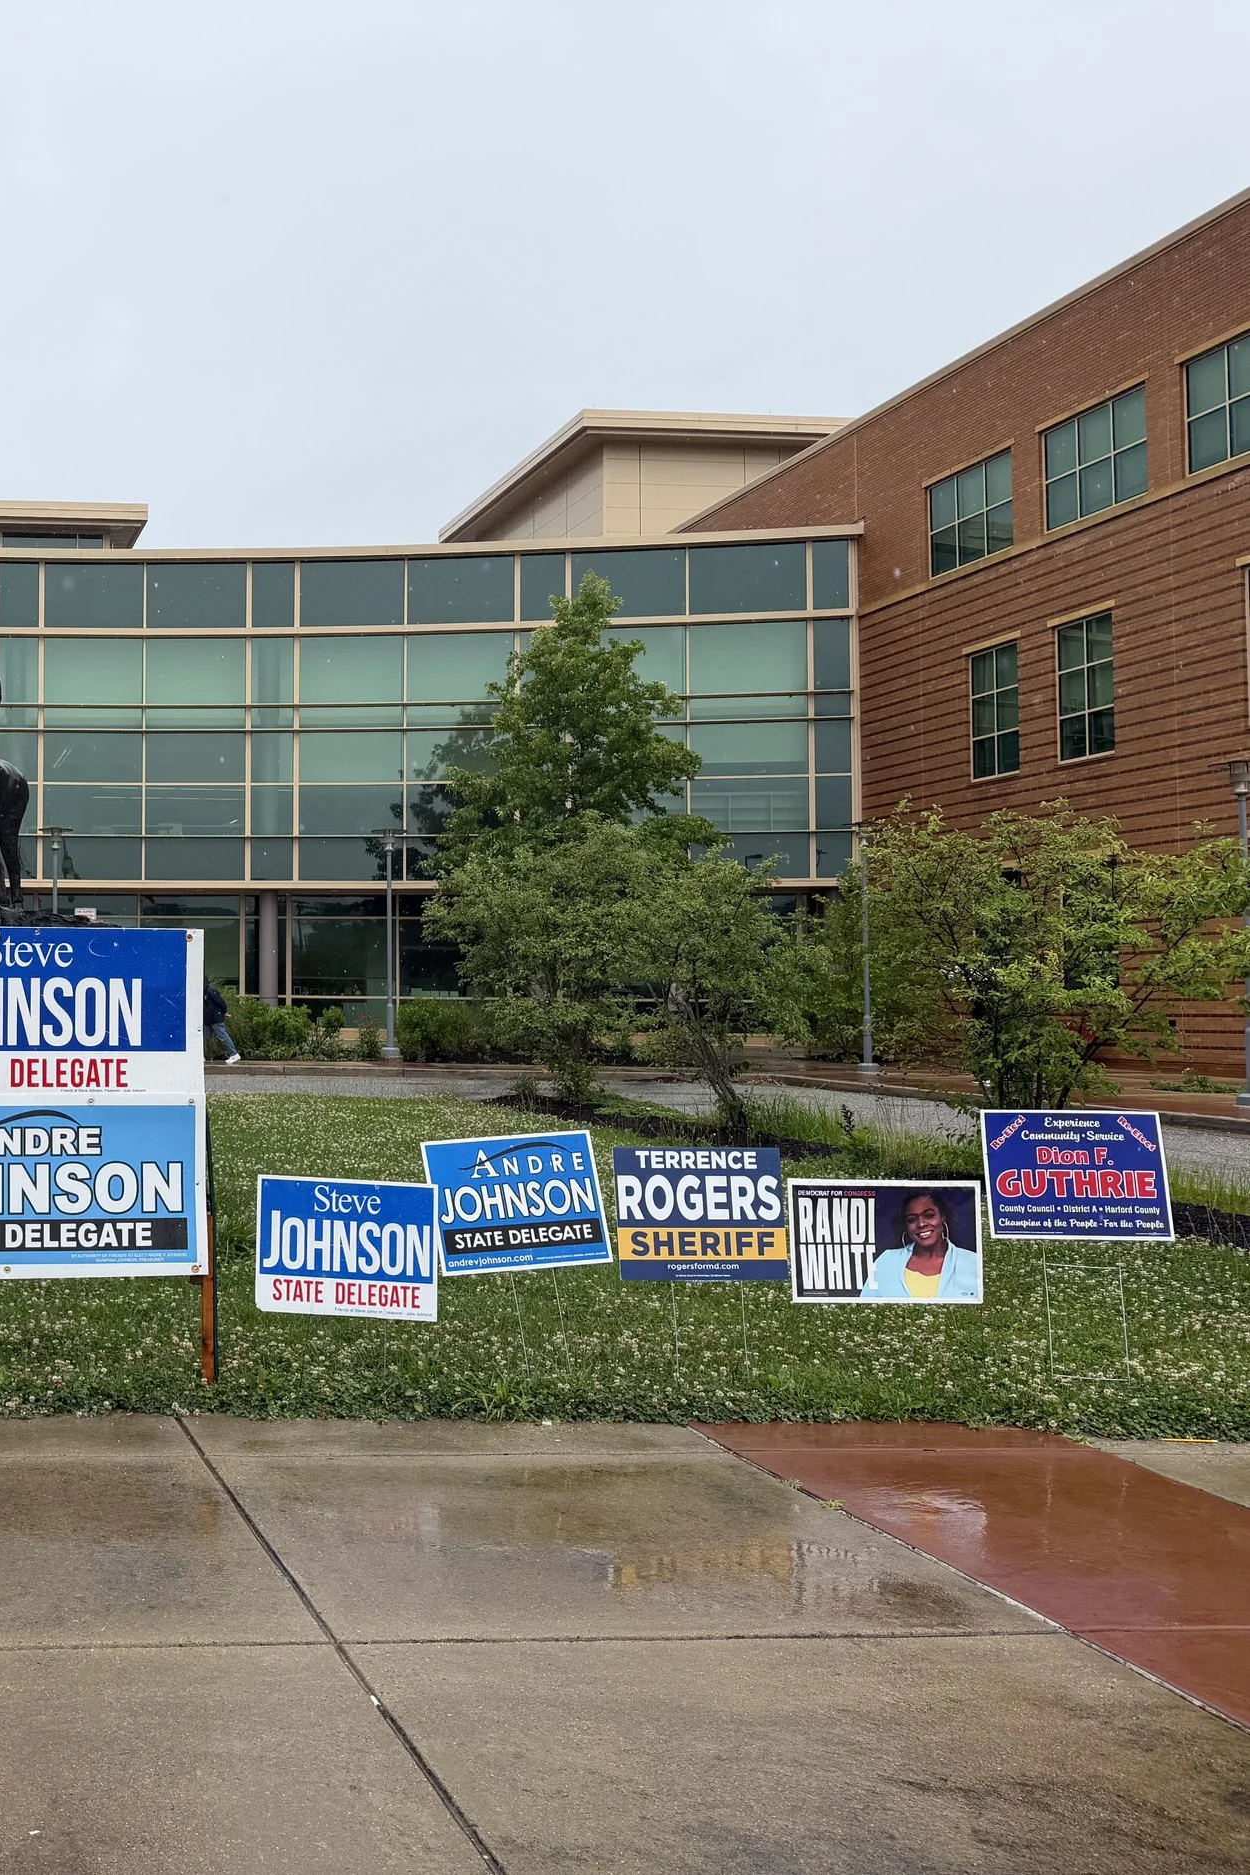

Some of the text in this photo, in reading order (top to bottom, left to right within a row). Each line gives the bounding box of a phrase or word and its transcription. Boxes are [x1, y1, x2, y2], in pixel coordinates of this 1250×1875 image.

[10, 1058, 130, 1088] DELEGATE
[990, 1114, 1027, 1150] Re-Elect
[1021, 1130, 1125, 1142] Community Service
[1044, 1116, 1100, 1128] Experience
[1117, 1116, 1157, 1152] Re-Elect
[470, 1148, 585, 1179] ANDRE
[635, 1150, 758, 1170] TERRENCE
[1036, 1146, 1114, 1165] Dion F.
[314, 1184, 382, 1214] Steve
[616, 1174, 782, 1221] ROGERS
[996, 1169, 1157, 1199] GUTHRIE
[440, 1177, 596, 1224] JOHNSON
[999, 1204, 1025, 1213] County
[1027, 1204, 1055, 1212] Council
[1104, 1205, 1132, 1213] Harford
[1134, 1206, 1160, 1215] County
[5, 1222, 153, 1248] DELEGATE
[798, 1197, 876, 1243] RANDI
[998, 1218, 1165, 1230] Champion of the People For the People
[263, 1210, 431, 1278] JOHNSON
[454, 1224, 593, 1250] STATE DELEGATE
[630, 1231, 775, 1257] SHERIFF
[448, 1254, 534, 1268] andrevjohnson.com
[667, 1262, 740, 1271] rogersformd.com
[800, 1244, 878, 1290] WHITE
[272, 1278, 421, 1308] STATE DELEGATE
